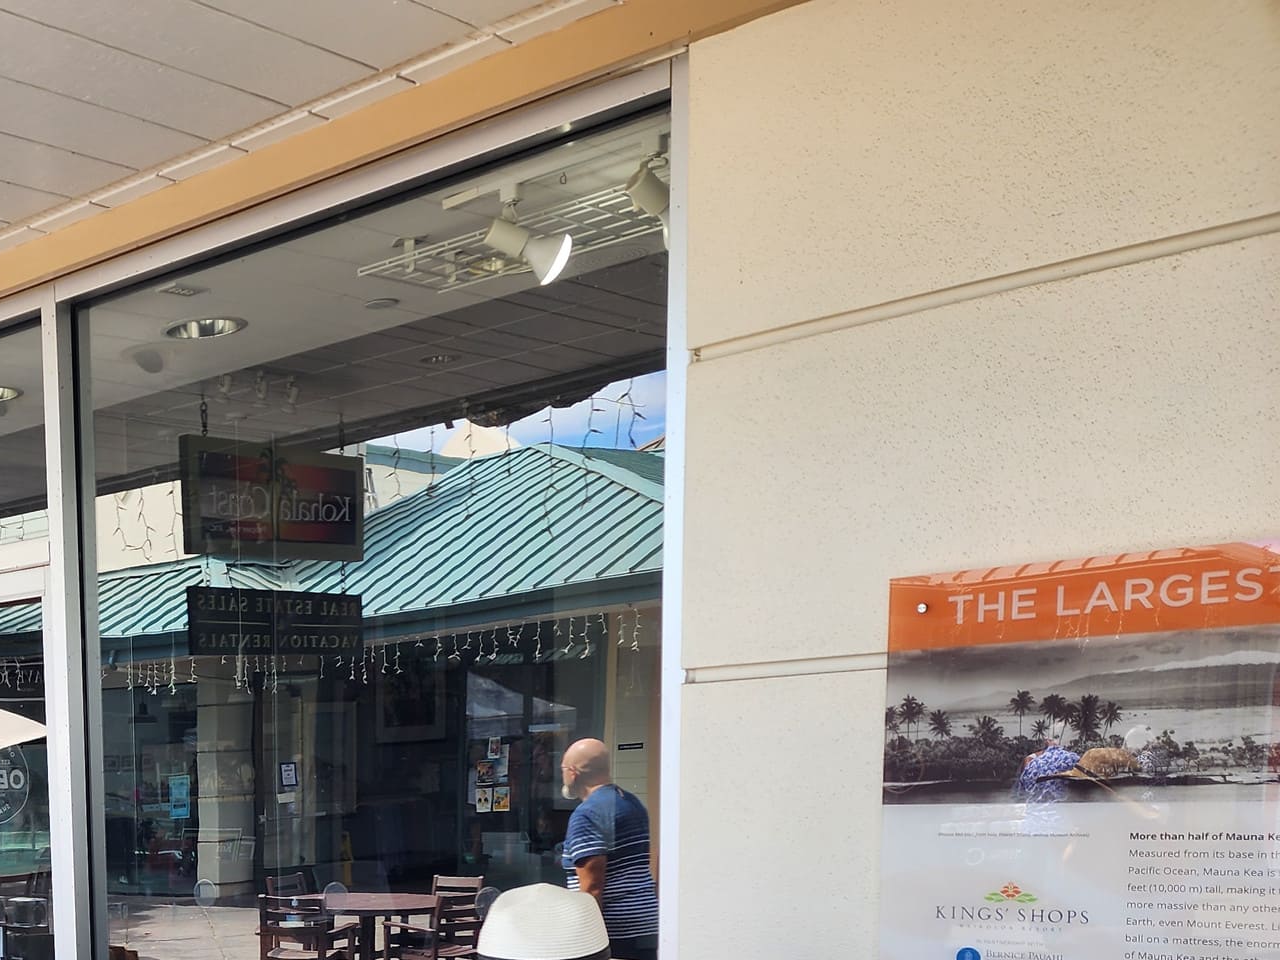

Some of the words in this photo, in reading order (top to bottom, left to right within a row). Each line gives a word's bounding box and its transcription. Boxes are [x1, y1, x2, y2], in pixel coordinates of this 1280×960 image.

[948, 588, 1038, 625] THE
[1056, 565, 1280, 617] LARGES
[1129, 832, 1157, 841] More
[1160, 832, 1185, 841] than
[1188, 832, 1209, 841] half
[1211, 832, 1223, 841] of
[1226, 833, 1265, 841] Mauna
[1128, 849, 1180, 858] Measured
[1184, 850, 1209, 858] from
[1212, 850, 1225, 859] its
[1228, 850, 1254, 859] base
[1257, 850, 1267, 859] in
[1128, 866, 1160, 875] Pacific
[1163, 867, 1200, 877] Ocean,
[1203, 867, 1240, 877] Mauna
[1243, 868, 1264, 877] Kea
[1267, 868, 1276, 877] is
[1127, 883, 1146, 892] feet
[1148, 883, 1186, 894] (10,000
[1188, 884, 1203, 894] m)
[1205, 885, 1223, 895] tall,
[1226, 886, 1266, 896] making
[1269, 886, 1276, 895] it
[1126, 902, 1154, 910] more
[1156, 902, 1199, 911] massive
[1202, 903, 1226, 912] than
[1229, 904, 1249, 914] any
[936, 905, 1009, 921] KINGS'
[1017, 908, 1089, 924] SHOPS
[1126, 917, 1156, 928] Earth,
[1158, 919, 1183, 927] even
[1186, 919, 1221, 929] Mount
[1225, 920, 1268, 931] Everest.
[1125, 934, 1143, 943] ball
[1146, 936, 1160, 944] on
[1162, 936, 1169, 944] a
[1172, 936, 1222, 947] mattress,
[1225, 938, 1243, 947] the
[1124, 950, 1135, 959] of
[1138, 951, 1173, 960] Mauna
